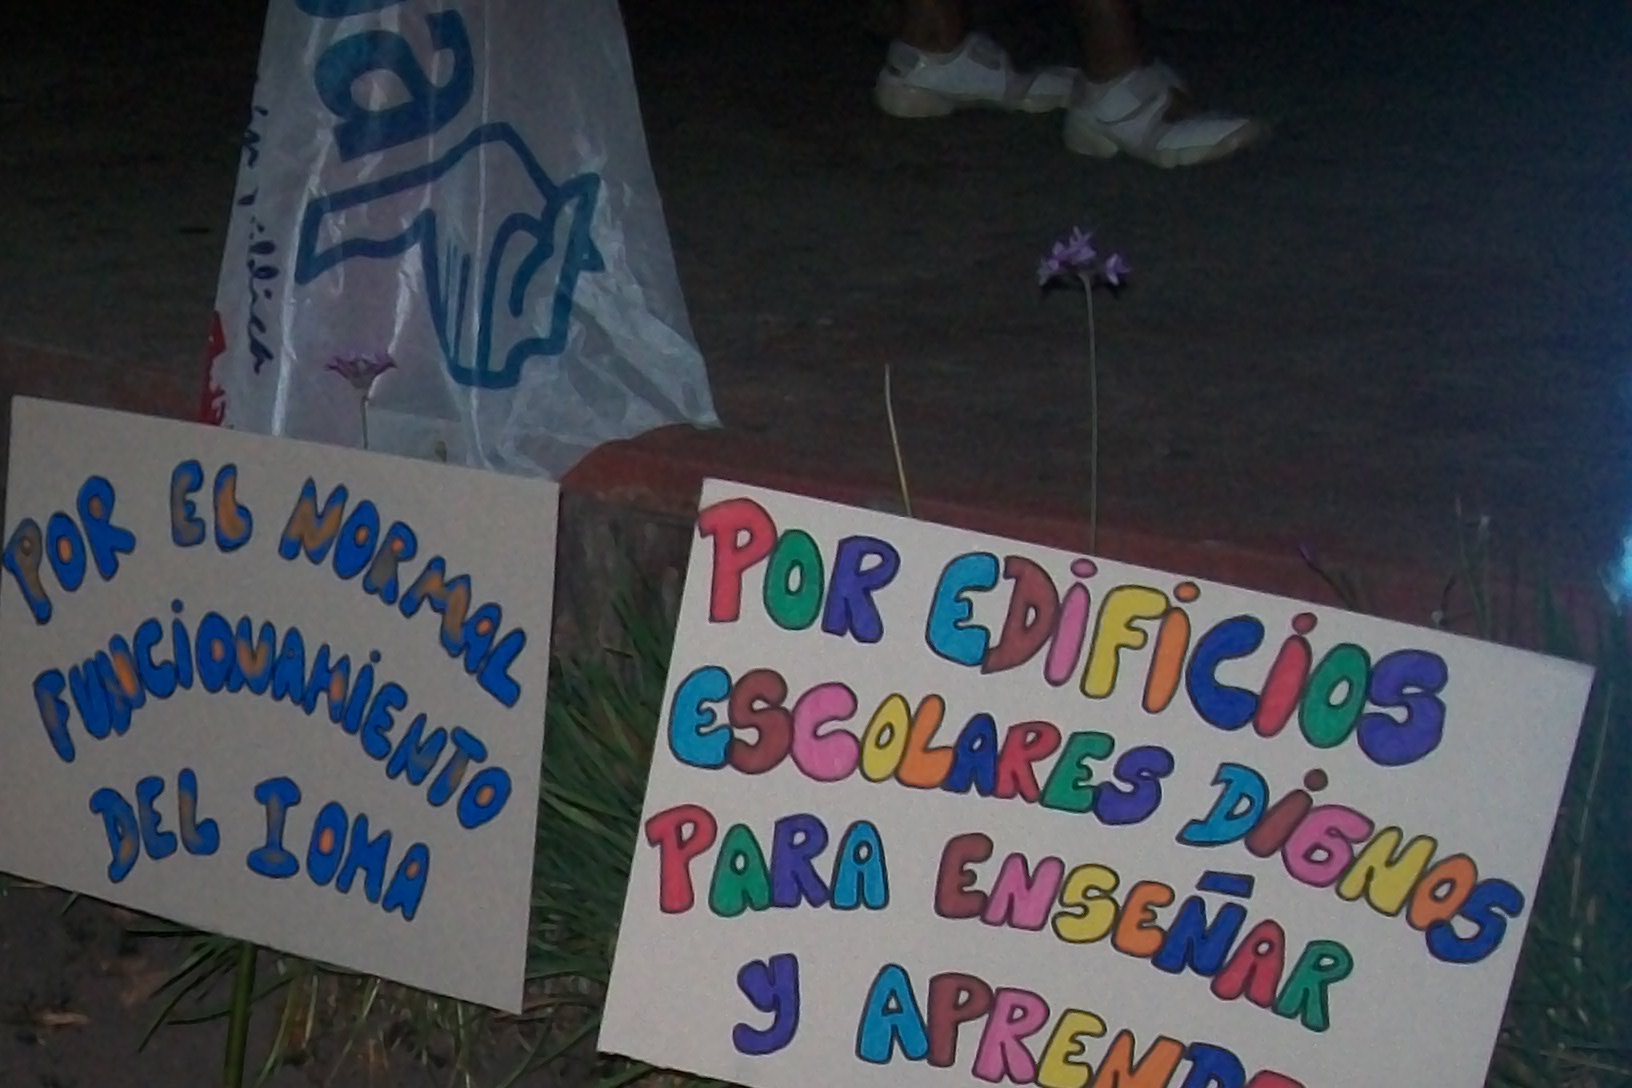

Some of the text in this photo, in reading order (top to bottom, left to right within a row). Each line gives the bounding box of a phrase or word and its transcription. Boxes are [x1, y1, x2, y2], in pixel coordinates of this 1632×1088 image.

[3, 459, 526, 708] POR EL NORMAL
[698, 497, 900, 644] POR
[668, 665, 1175, 826] ESCOLARES
[89, 767, 430, 922] DEL IOMA
[644, 804, 1354, 1033] PARA ENSEÑAR
